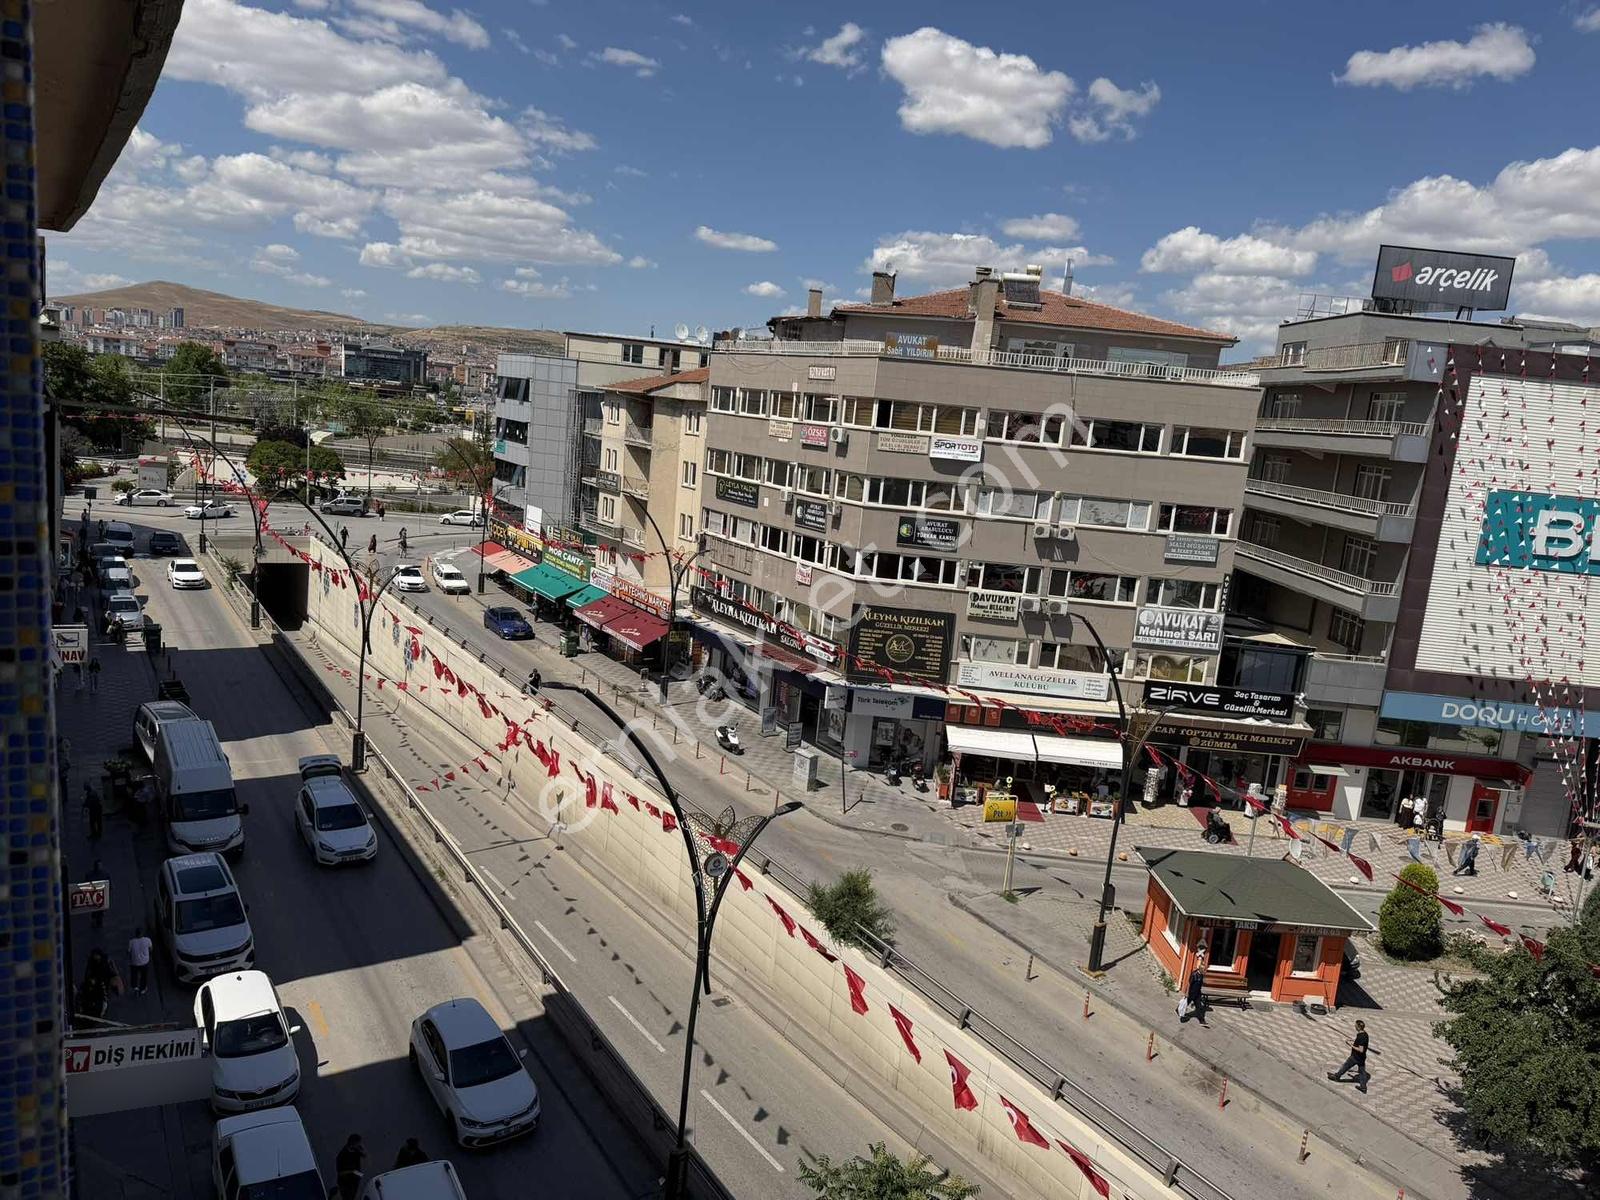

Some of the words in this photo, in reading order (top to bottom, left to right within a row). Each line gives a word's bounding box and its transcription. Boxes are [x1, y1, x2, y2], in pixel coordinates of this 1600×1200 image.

[1414, 265, 1499, 292] arçelik
[897, 335, 928, 346] AVUKAT
[807, 426, 827, 438] ÖZSES
[979, 593, 1016, 605] AVUKAT
[1221, 575, 1230, 612] AVUKAT
[711, 599, 739, 620] ALEYNA
[739, 610, 777, 635] KIZILKAN
[862, 611, 898, 622] ALEYNA
[899, 615, 945, 627] KIZILKAN
[1154, 612, 1206, 632] AVUKAT
[875, 621, 903, 630] GÜZELLİK
[904, 625, 930, 633] MERKEZİ
[1139, 626, 1186, 640] Mehmet
[1187, 631, 1216, 642] SARI
[988, 670, 1033, 682] AVELLANA
[1033, 673, 1077, 686] GÜZELLİK
[1013, 681, 1050, 691] KULÜBÜ
[1149, 685, 1221, 706] ZİRVE
[1233, 691, 1250, 702] Saç
[1250, 691, 1282, 702] Tasarım
[1223, 703, 1257, 713] Güzellik
[1256, 706, 1288, 717] Merkezi
[1441, 702, 1515, 726] DOQU
[1179, 728, 1220, 739] TOPTAN
[1223, 732, 1248, 742] TAKI
[1249, 734, 1296, 746] MARKET
[1390, 755, 1456, 770] AKBANK
[72, 890, 105, 907] TAÇ
[94, 1044, 125, 1067] DİŞ
[130, 1036, 197, 1061] HEKİMİ
